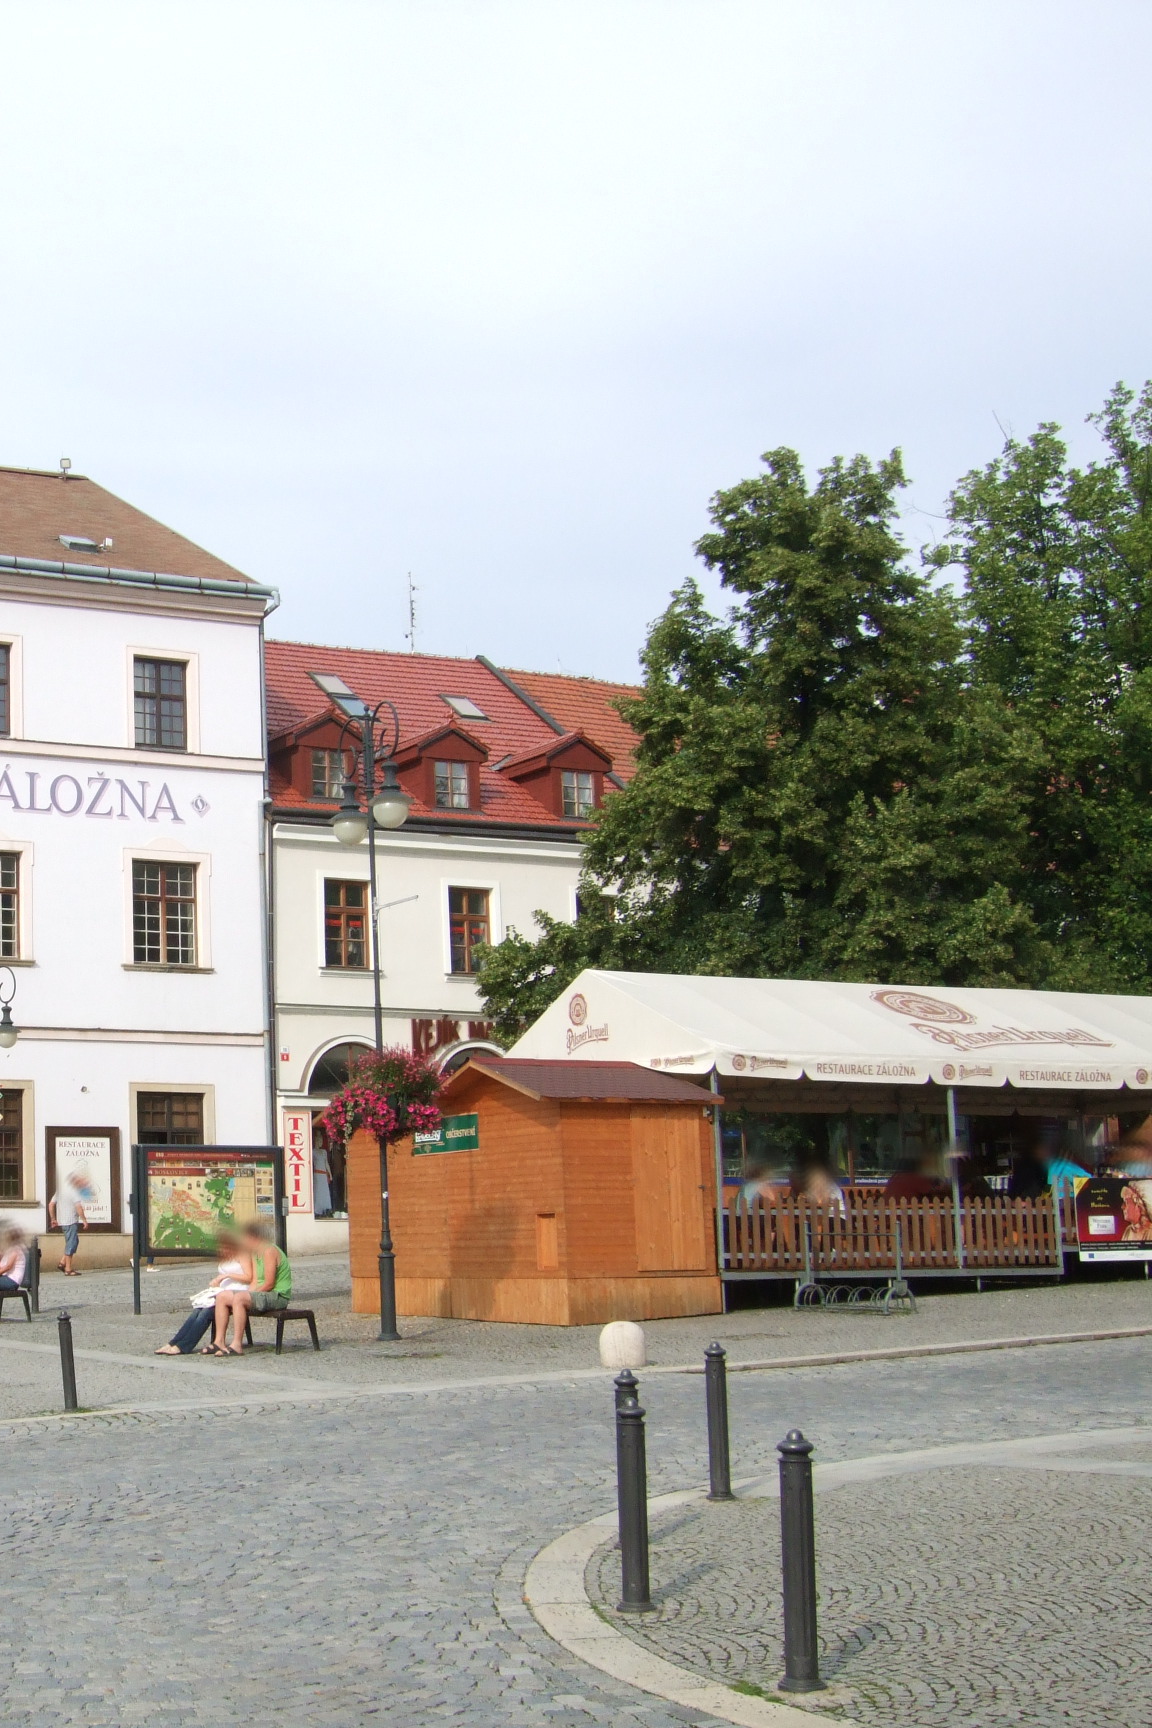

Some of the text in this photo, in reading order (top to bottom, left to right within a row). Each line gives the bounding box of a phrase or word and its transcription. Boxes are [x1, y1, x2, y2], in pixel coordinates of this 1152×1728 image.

[566, 1023, 609, 1055] Pilsner Urquell
[908, 1022, 1104, 1051] Pilsner Urquell
[816, 1062, 917, 1078] RESTAURACE ZÁLOŽNA
[1019, 1069, 1113, 1083] RESTAURACE ZÁLOŽNA
[58, 1141, 105, 1149] RESTAURACE
[65, 1149, 100, 1157] ZÁLOŽNA
[287, 1117, 306, 1208] TEXTIL
